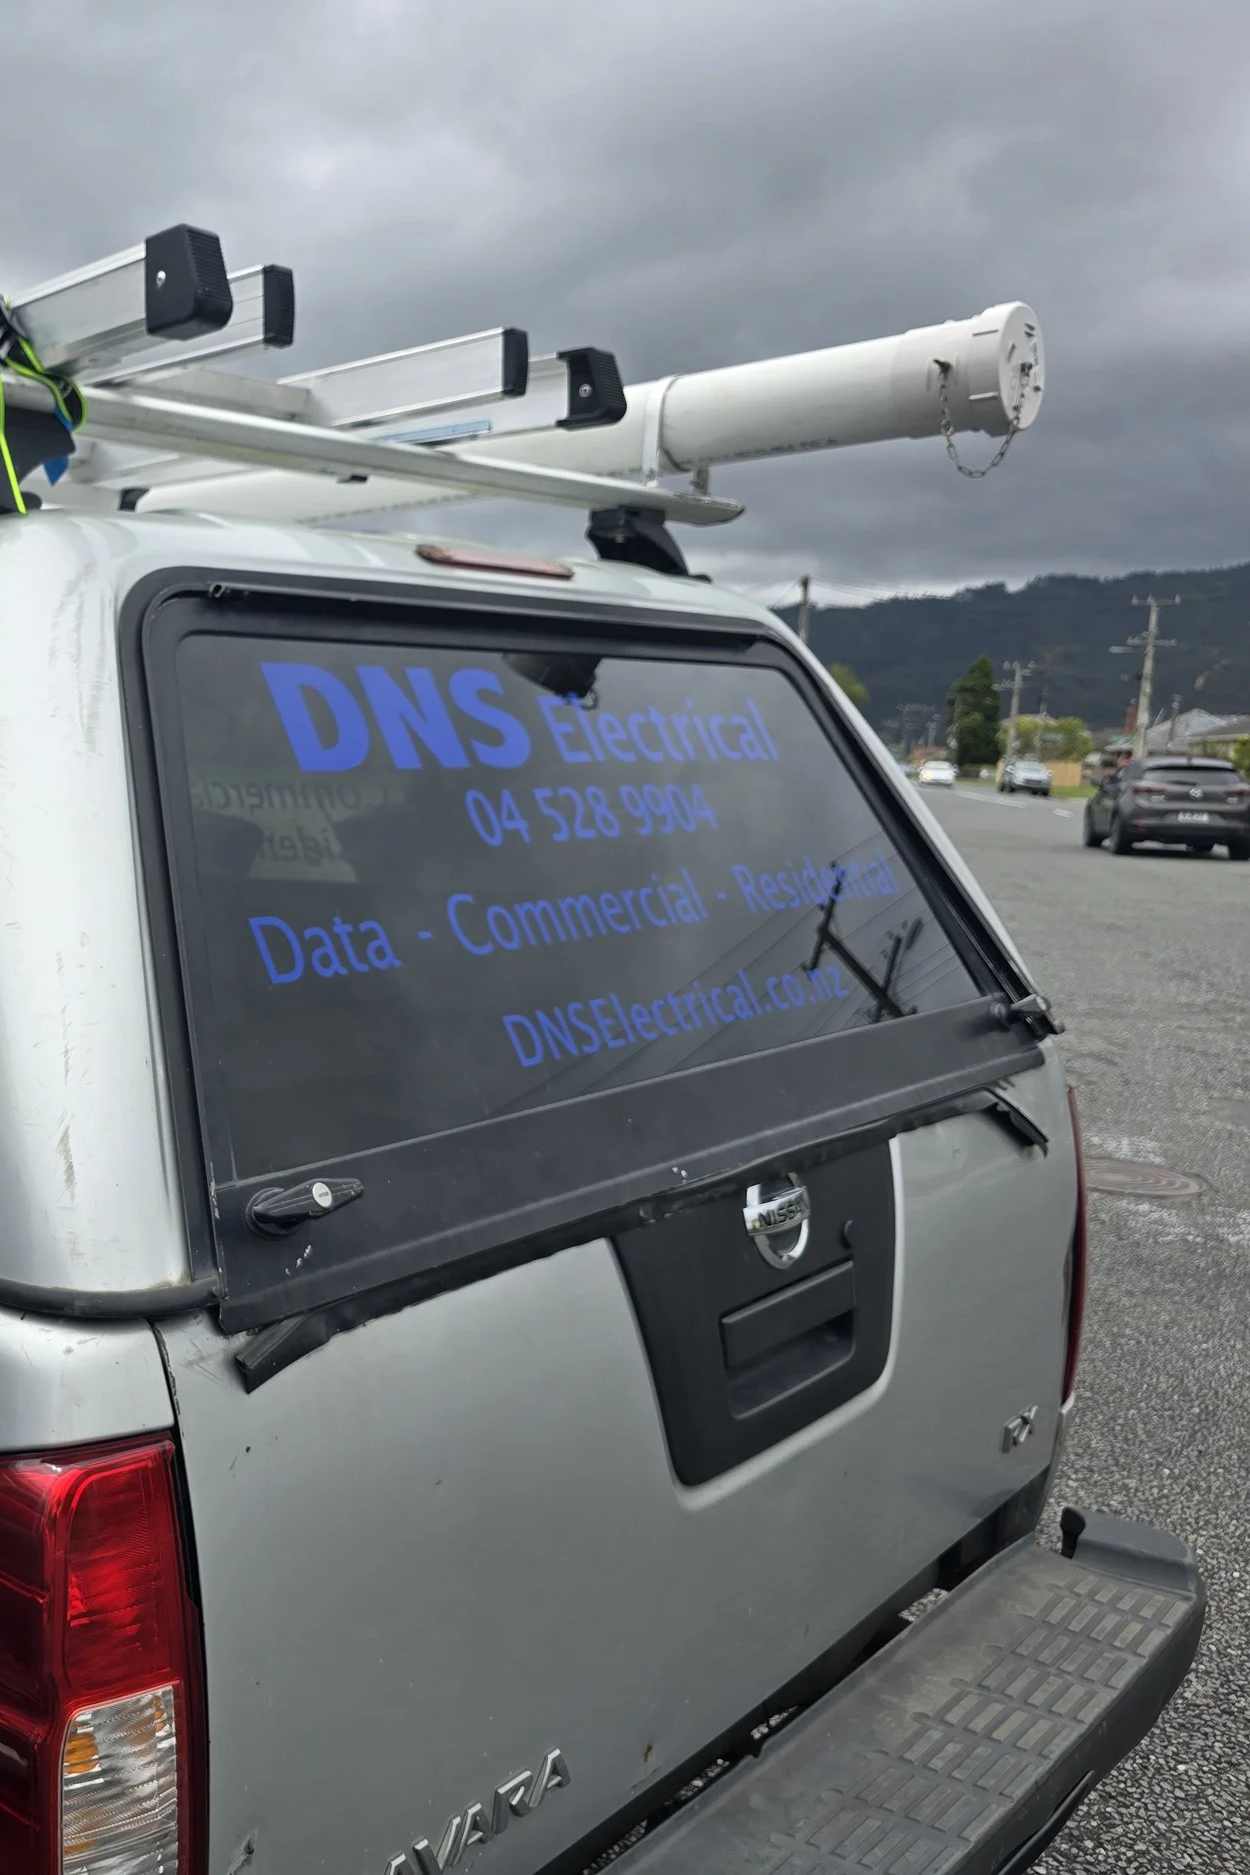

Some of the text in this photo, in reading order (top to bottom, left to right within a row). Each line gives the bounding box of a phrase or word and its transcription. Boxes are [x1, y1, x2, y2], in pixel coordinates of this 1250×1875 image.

[258, 661, 779, 774] DNS Electrical
[464, 783, 717, 848] 04 528 9904
[249, 915, 402, 985] Data
[446, 869, 708, 956] Commercial
[731, 846, 899, 913] Residential
[502, 965, 850, 1069] DNSElectrical.co.nz
